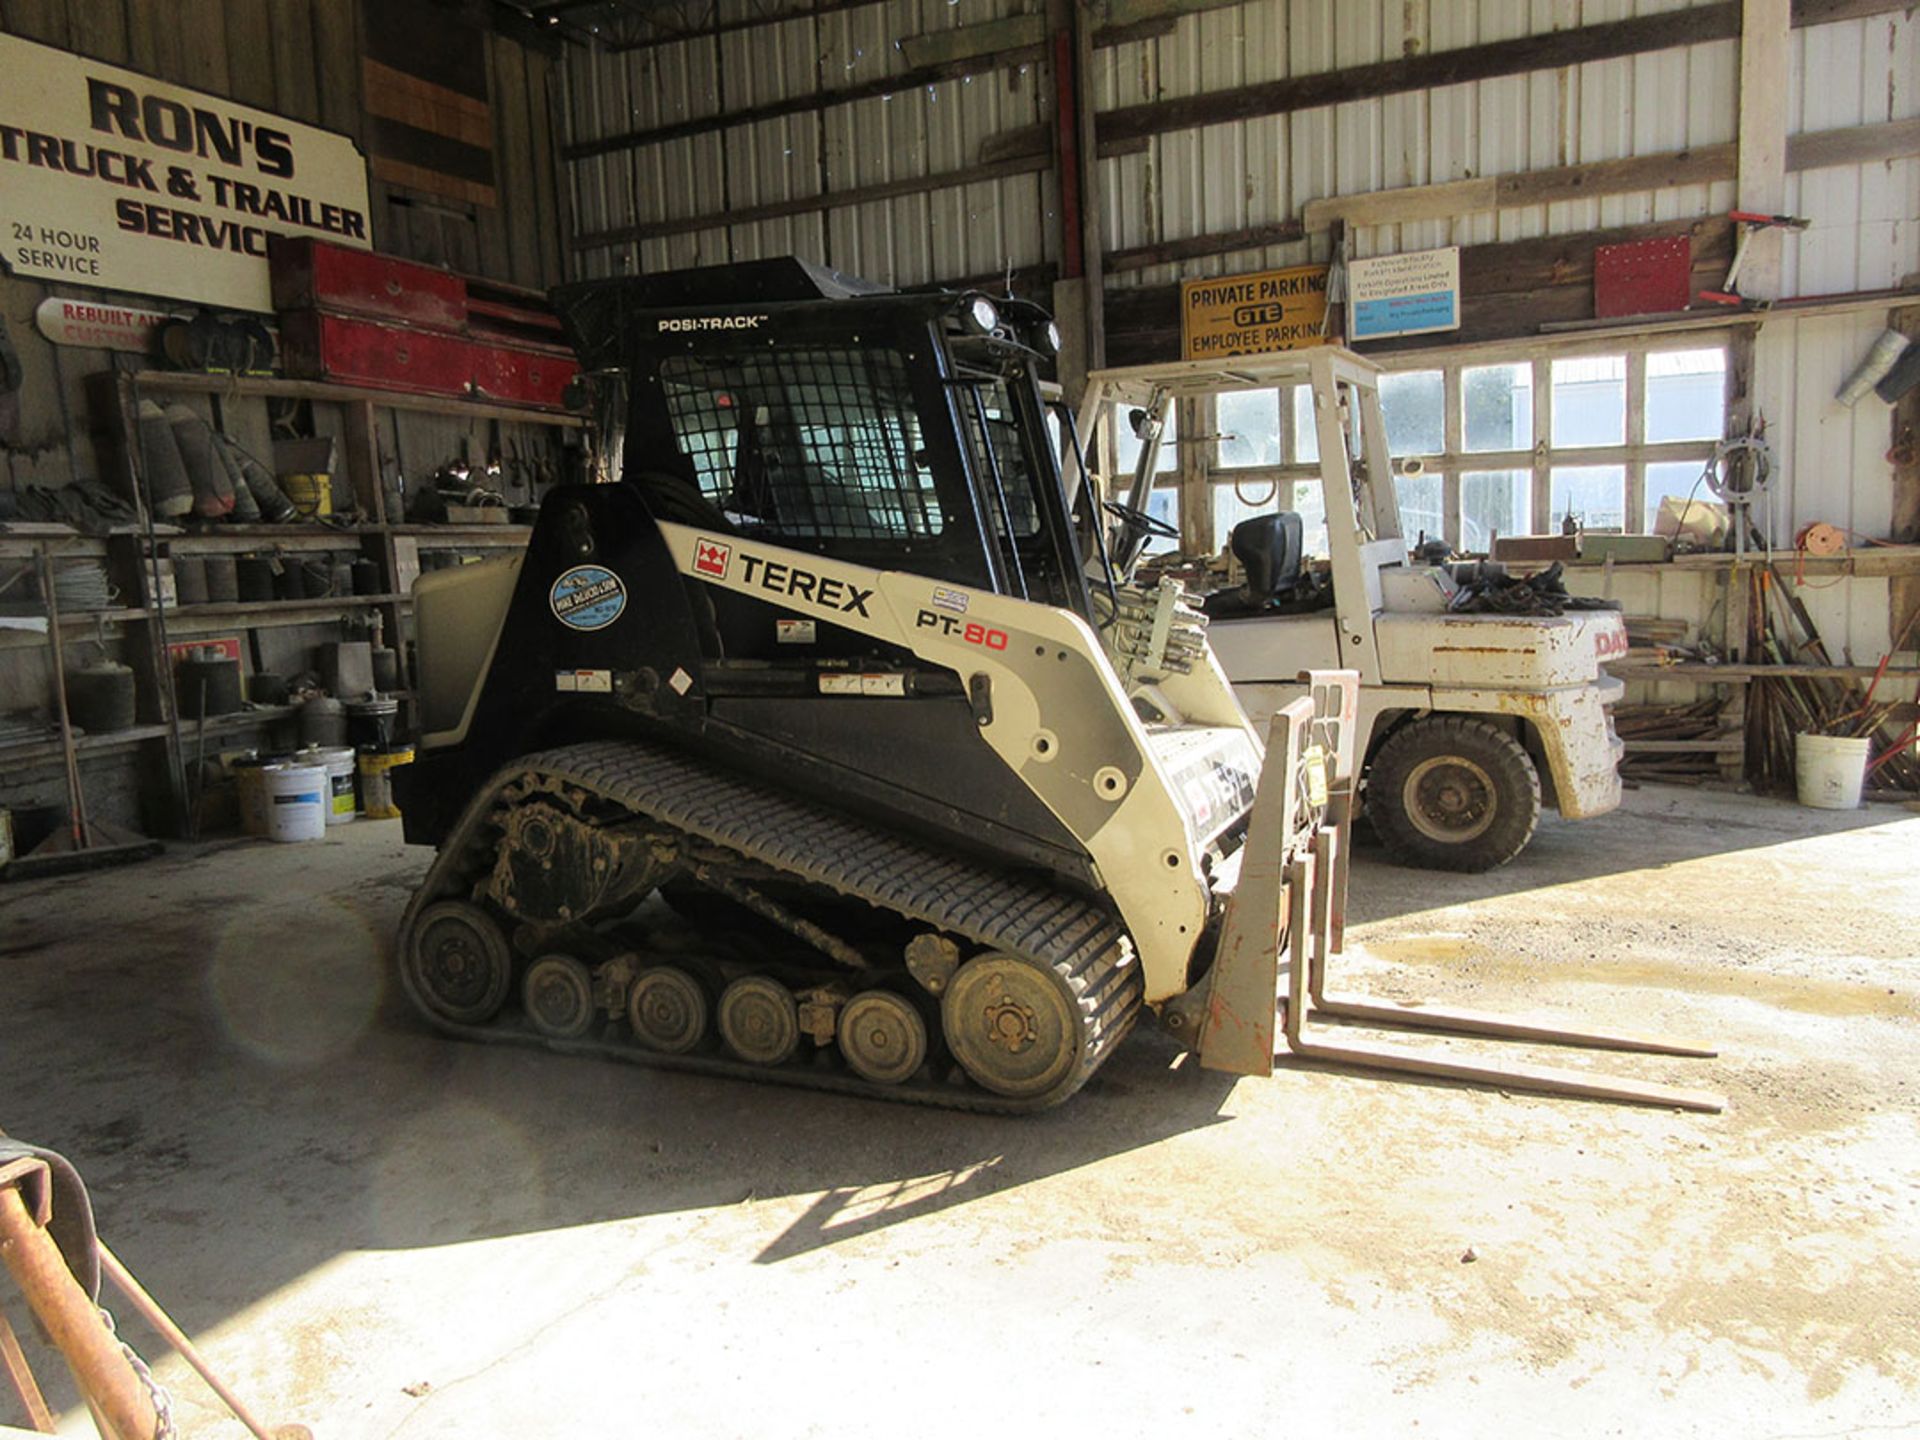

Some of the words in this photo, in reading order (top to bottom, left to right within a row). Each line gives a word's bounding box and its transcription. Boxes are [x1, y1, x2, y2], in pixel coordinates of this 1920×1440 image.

[86, 76, 295, 180] RON'S
[0, 124, 160, 193] TRUCK
[166, 165, 202, 202] &
[207, 174, 367, 240] TRAILER
[12, 222, 34, 242] 24
[40, 228, 100, 253] HOUR
[17, 248, 101, 276] SERVICE
[1191, 283, 1255, 309] PRIVATE
[1260, 273, 1327, 299] PARKING
[63, 303, 133, 326] REBUILT
[1236, 304, 1281, 324] GTE
[1193, 331, 1260, 352] EMPLOYEE
[1265, 321, 1329, 343] PARKING
[740, 553, 874, 619] TEREX
[916, 609, 1009, 651] PT-80
